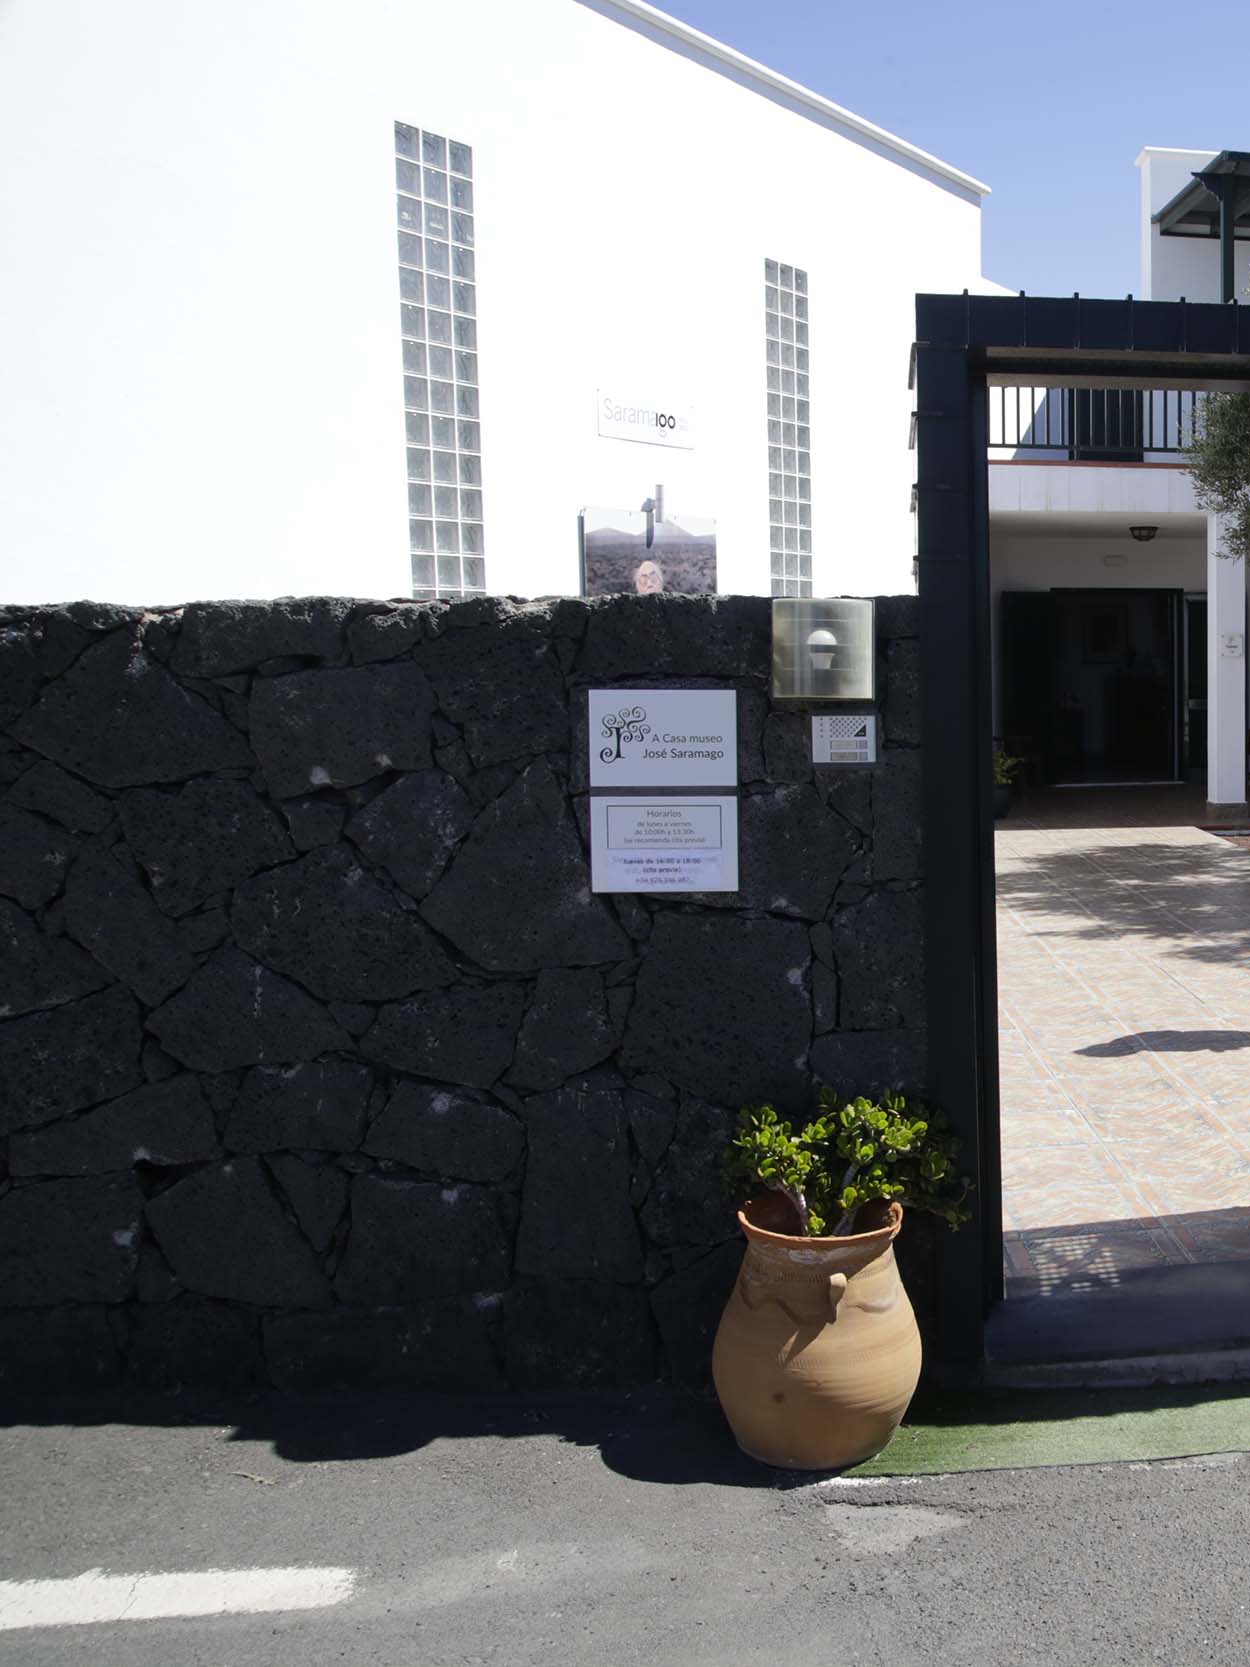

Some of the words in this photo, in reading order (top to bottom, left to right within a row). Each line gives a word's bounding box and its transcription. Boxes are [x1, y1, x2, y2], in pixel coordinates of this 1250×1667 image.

[651, 733, 661, 744] A
[662, 733, 687, 744] Casa
[689, 734, 723, 744] museo
[642, 747, 668, 759] José
[670, 748, 724, 760] Saramago
[646, 809, 682, 818] Horarios
